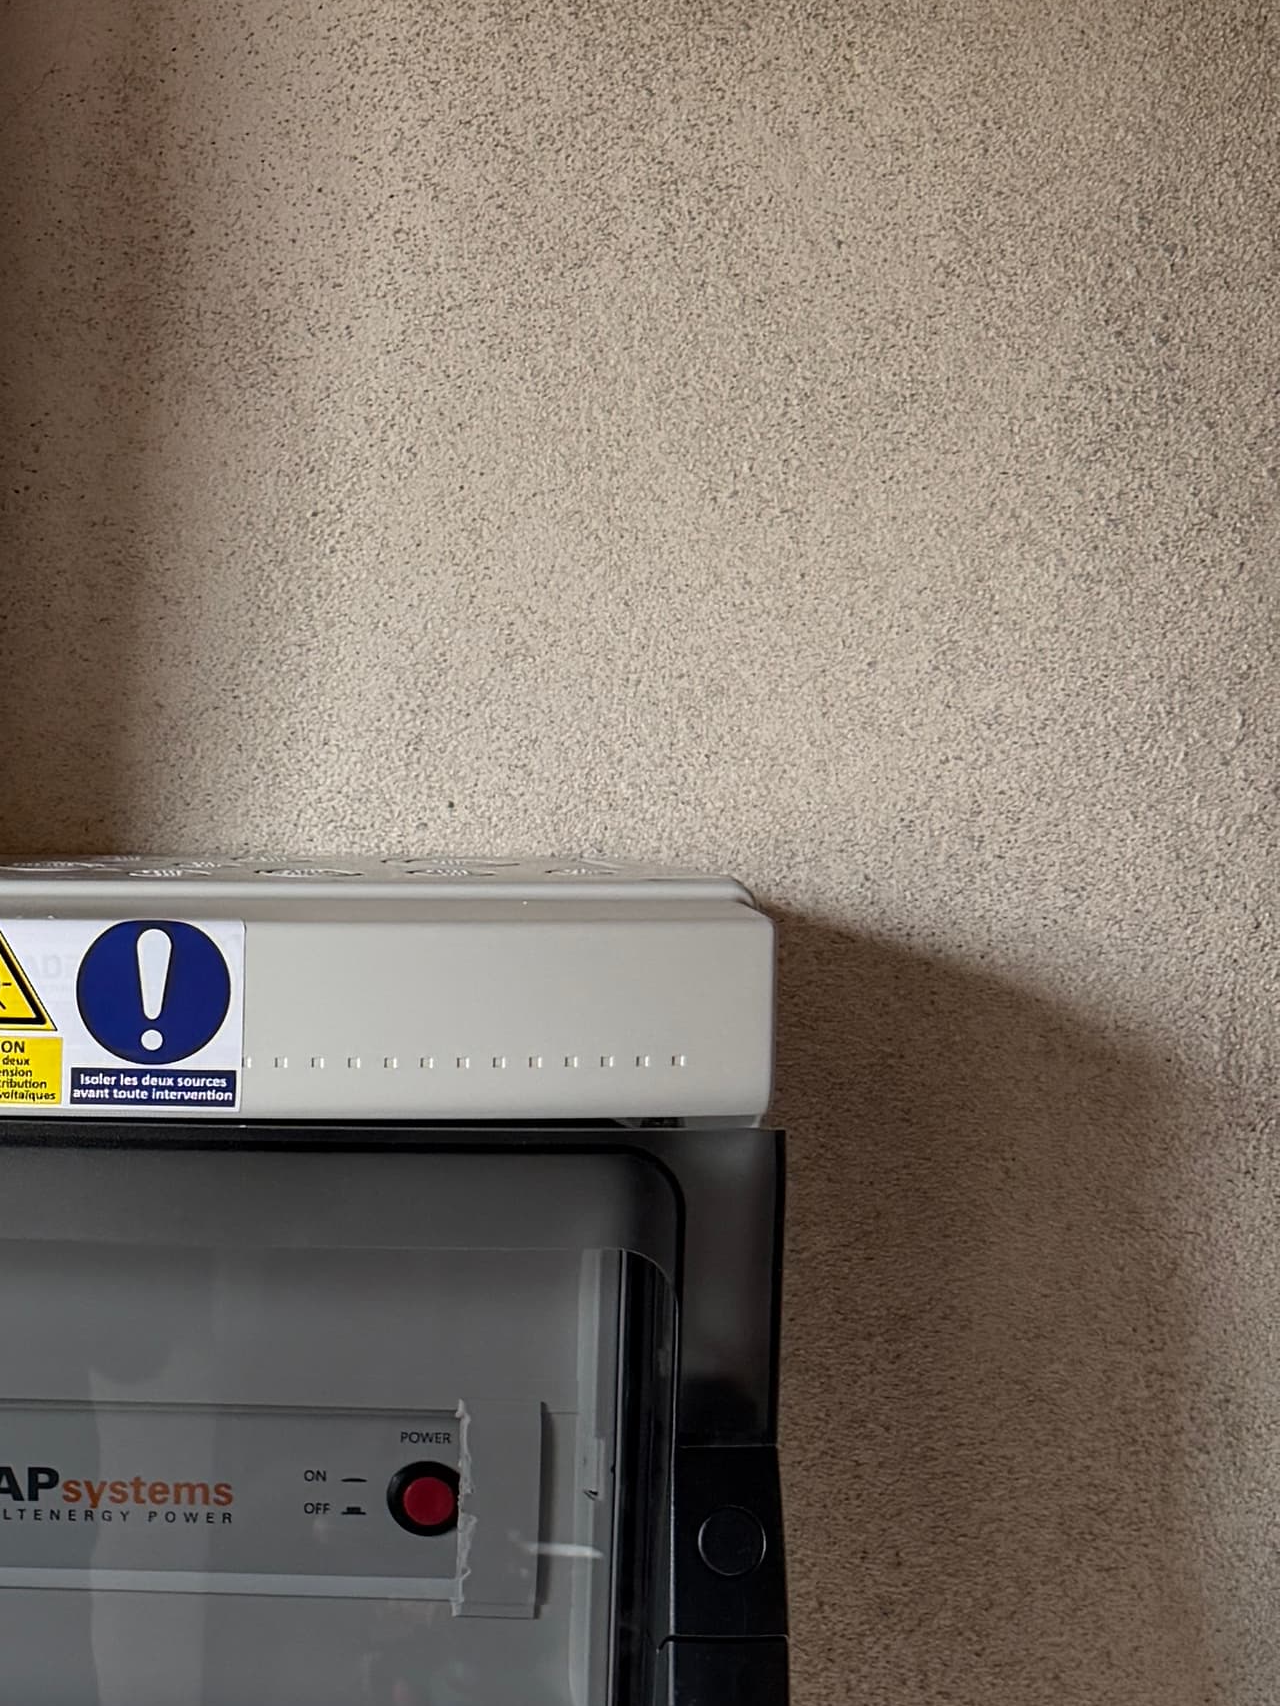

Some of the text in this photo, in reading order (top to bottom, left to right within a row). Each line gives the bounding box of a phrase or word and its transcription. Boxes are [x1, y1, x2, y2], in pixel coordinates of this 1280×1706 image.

[2, 1055, 30, 1066] deux
[80, 1073, 227, 1087] Isoler les deux sources
[73, 1088, 233, 1101] avant toute intervention
[400, 1431, 452, 1444] POWER
[303, 1469, 327, 1482] ON
[303, 1503, 331, 1515] OFF
[147, 1510, 234, 1526] POWER
